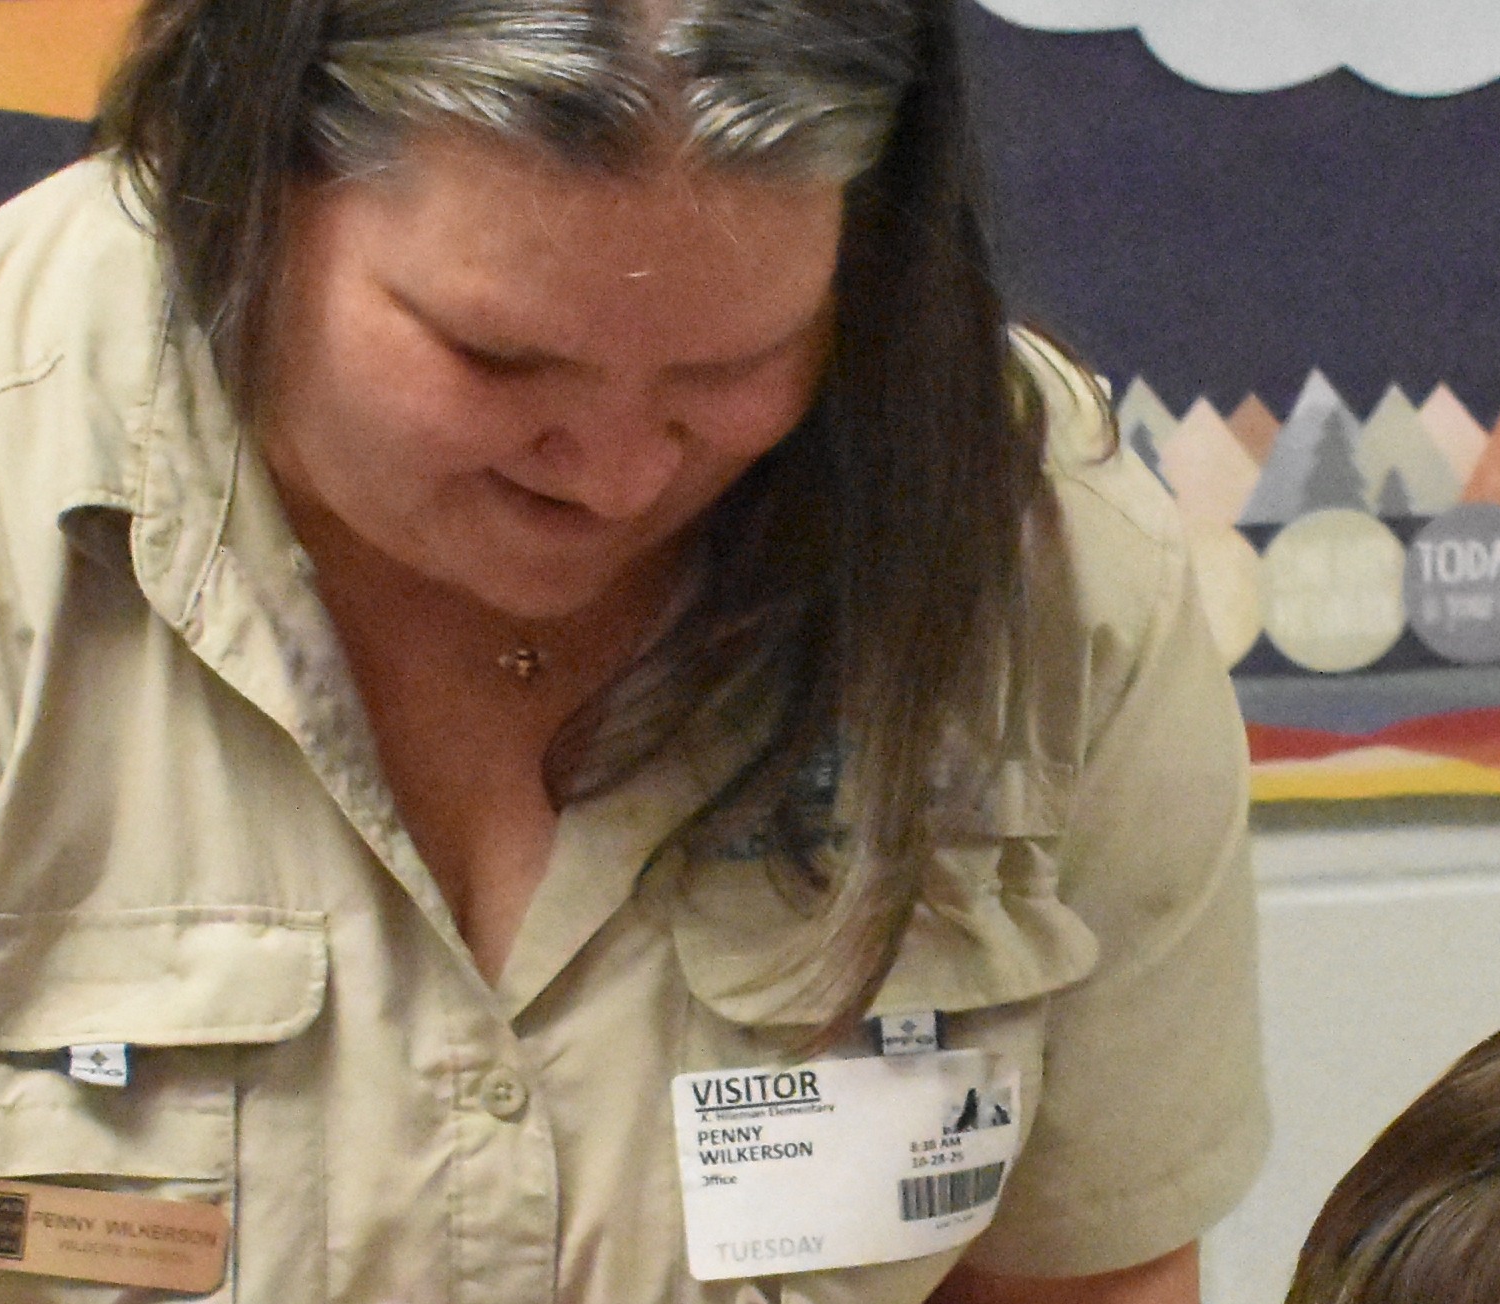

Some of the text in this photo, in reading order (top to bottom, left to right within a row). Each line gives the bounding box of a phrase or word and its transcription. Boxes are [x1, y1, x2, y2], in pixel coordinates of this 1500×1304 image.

[692, 1071, 820, 1107] VISITOR
[697, 1125, 763, 1147] PENNY
[699, 1141, 814, 1166] WILKERSON
[31, 1210, 96, 1232] PENNY
[104, 1219, 218, 1248] WILKERSON
[716, 1235, 825, 1264] TUESDAY
